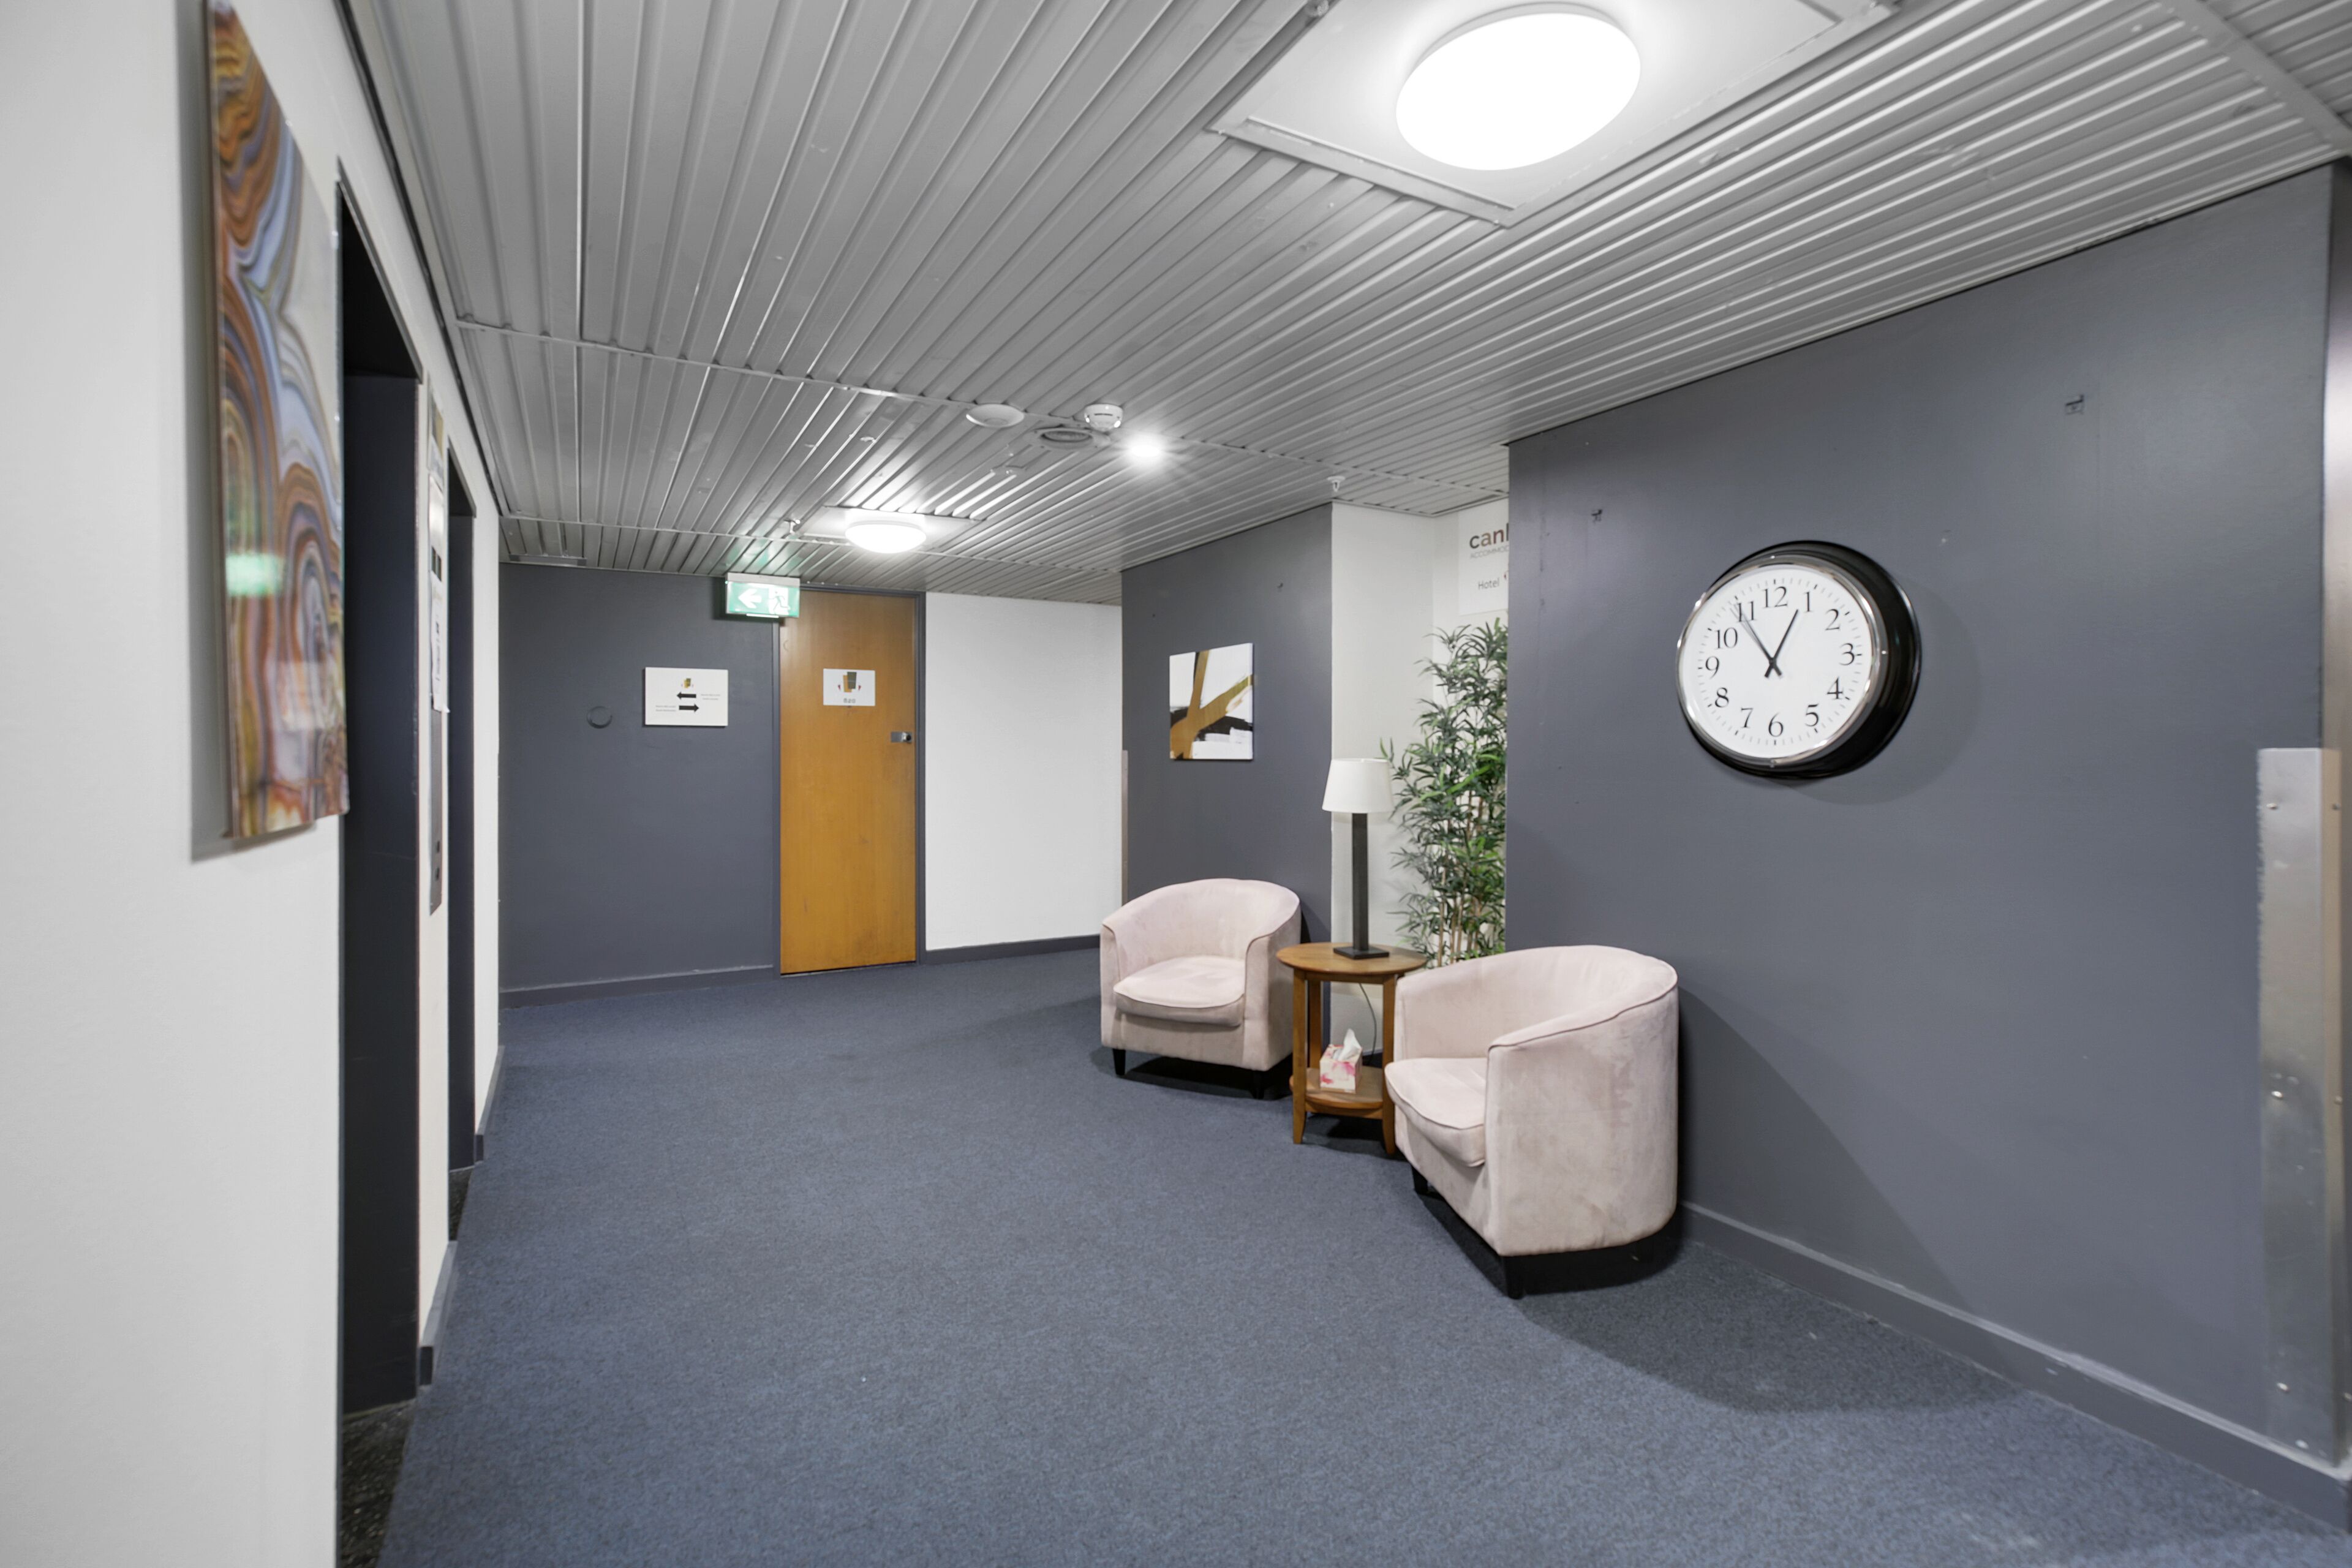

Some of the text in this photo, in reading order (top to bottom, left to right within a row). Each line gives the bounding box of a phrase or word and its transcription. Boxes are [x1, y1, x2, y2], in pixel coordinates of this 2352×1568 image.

[1478, 578, 1499, 590] Hotel
[1763, 586, 1788, 608] 12
[1804, 591, 1814, 612] 1
[1738, 601, 1757, 622] 11
[1825, 609, 1840, 631] 2
[1716, 627, 1738, 650] 10
[1840, 643, 1855, 665] 3
[1705, 656, 1719, 679] 9
[1715, 687, 1729, 708] 8
[1827, 677, 1843, 699] 4
[1741, 707, 1754, 728] 7
[1768, 713, 1784, 737] 6
[1806, 704, 1820, 727] 5
